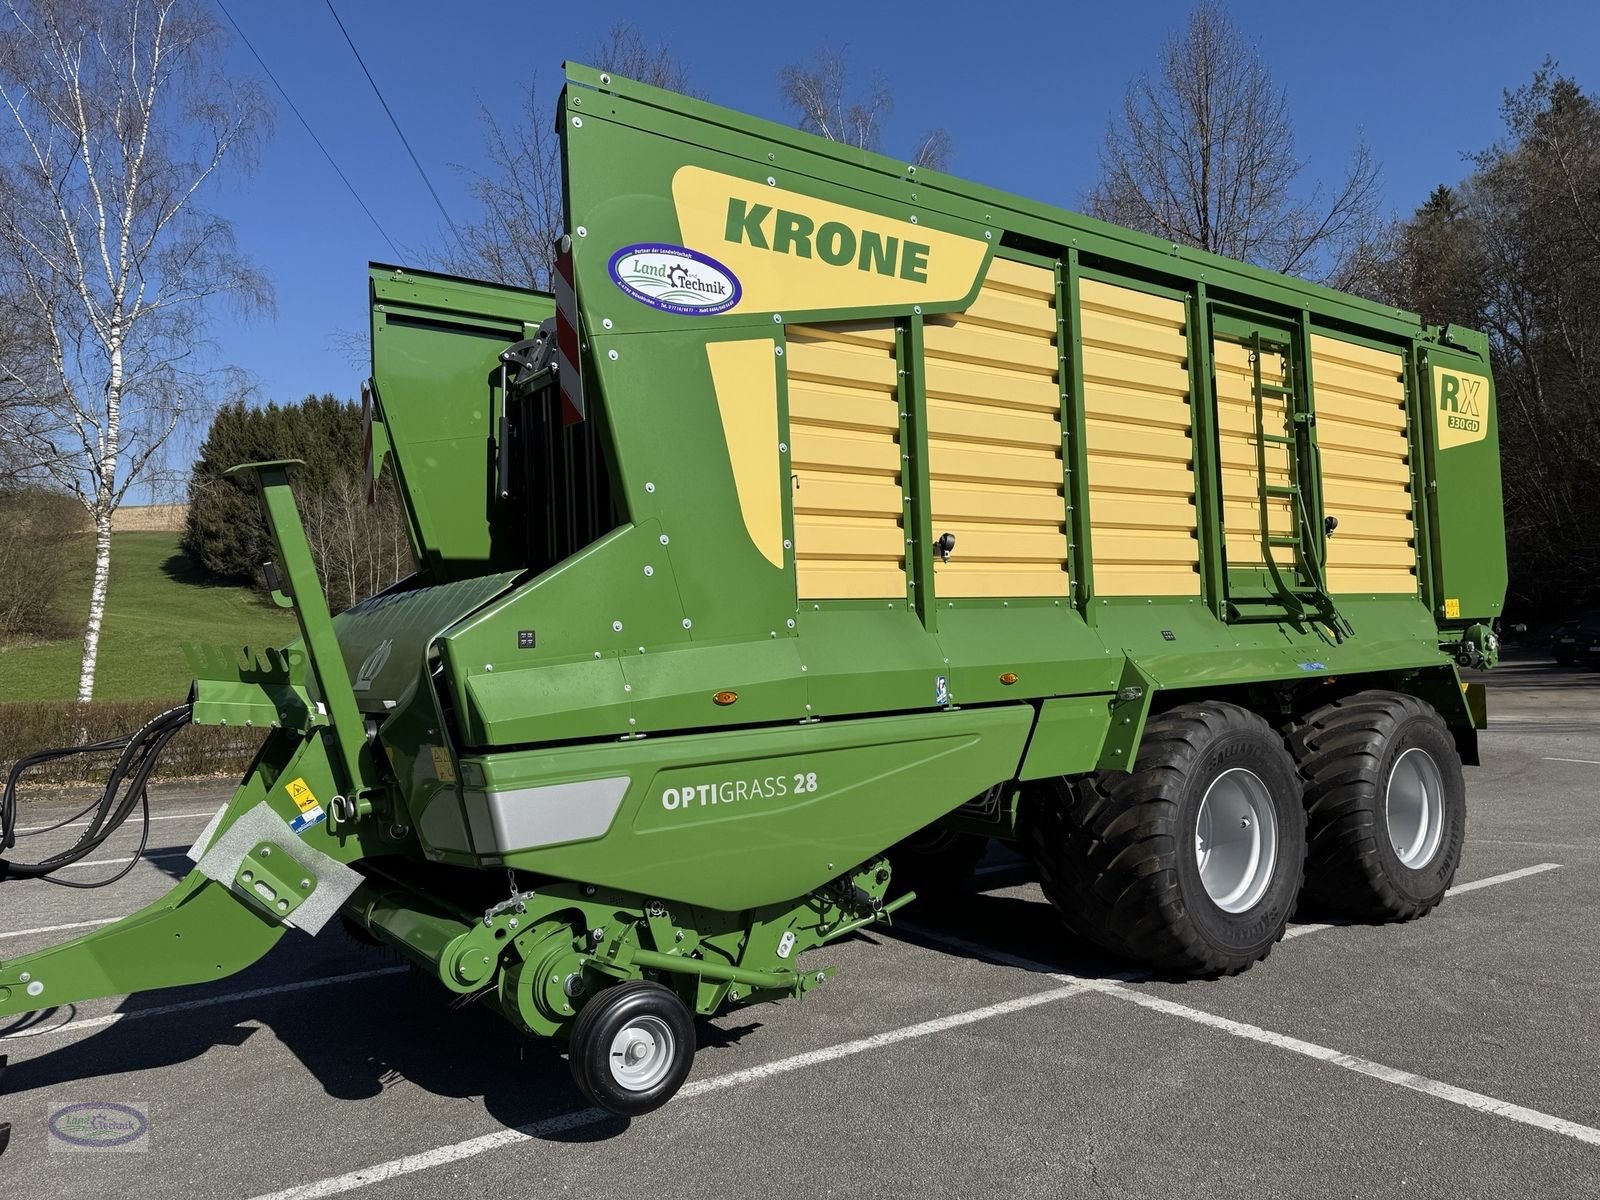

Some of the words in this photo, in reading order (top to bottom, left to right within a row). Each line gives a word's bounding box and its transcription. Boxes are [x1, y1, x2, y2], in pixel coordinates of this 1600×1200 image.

[724, 197, 930, 284] KRONE
[633, 259, 667, 278] Land
[678, 275, 726, 295] Technik
[1440, 374, 1480, 417] RX
[662, 776, 787, 810] OPTIGRASS
[793, 772, 818, 794] 28
